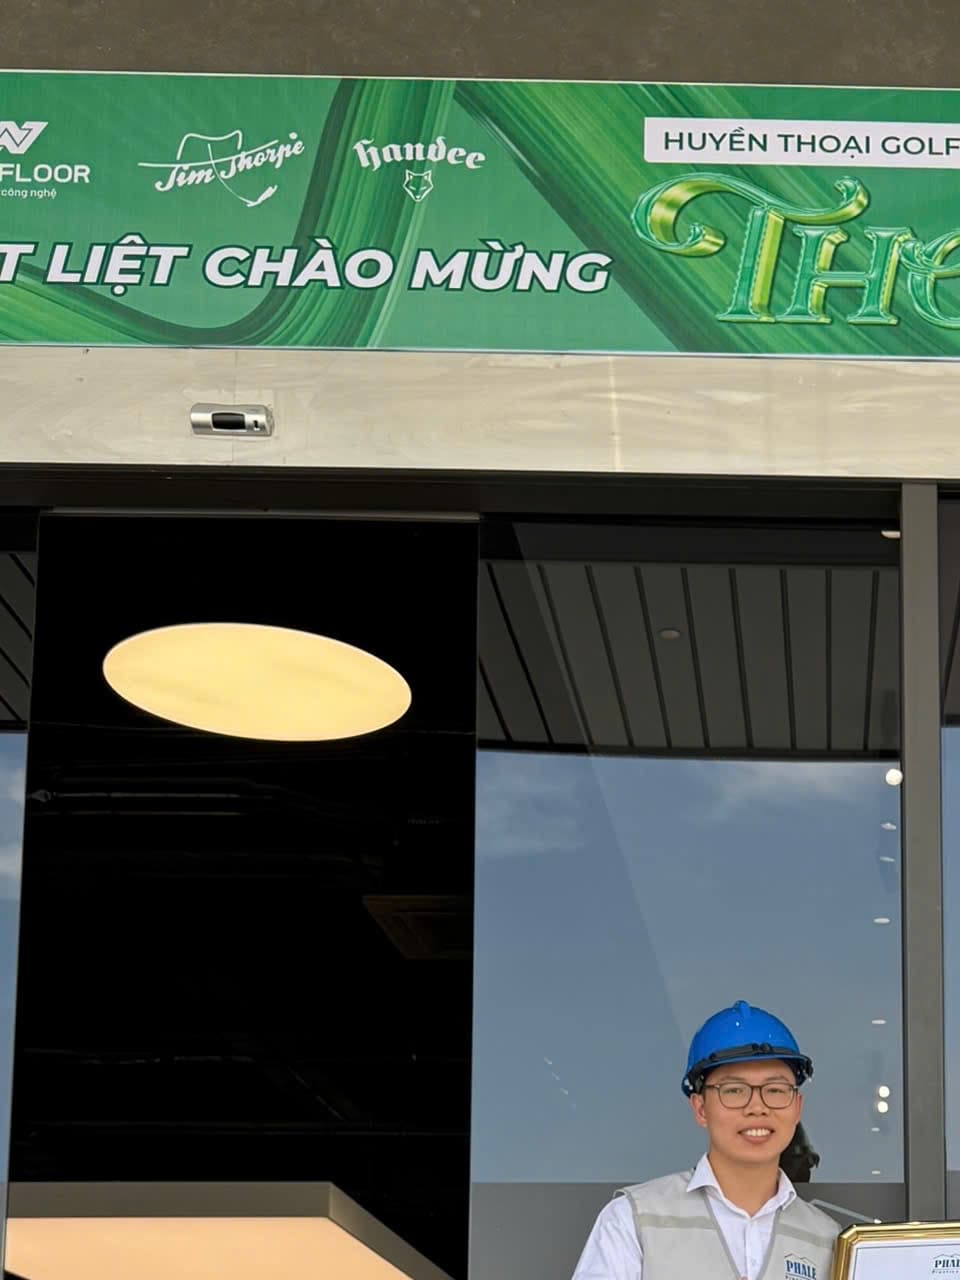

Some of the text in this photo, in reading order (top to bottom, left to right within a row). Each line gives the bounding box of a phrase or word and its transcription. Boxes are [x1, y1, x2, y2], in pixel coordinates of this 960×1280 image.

[664, 126, 960, 159] HUYỀN THOẠI GOLF
[0, 163, 91, 184] FLOOR
[154, 163, 215, 192] Jim
[1, 187, 57, 199] công nghệ
[45, 233, 191, 295] LIỆT
[204, 237, 394, 289] CHÀO
[410, 240, 613, 292] MỪNG
[786, 1260, 817, 1280] PHALE
